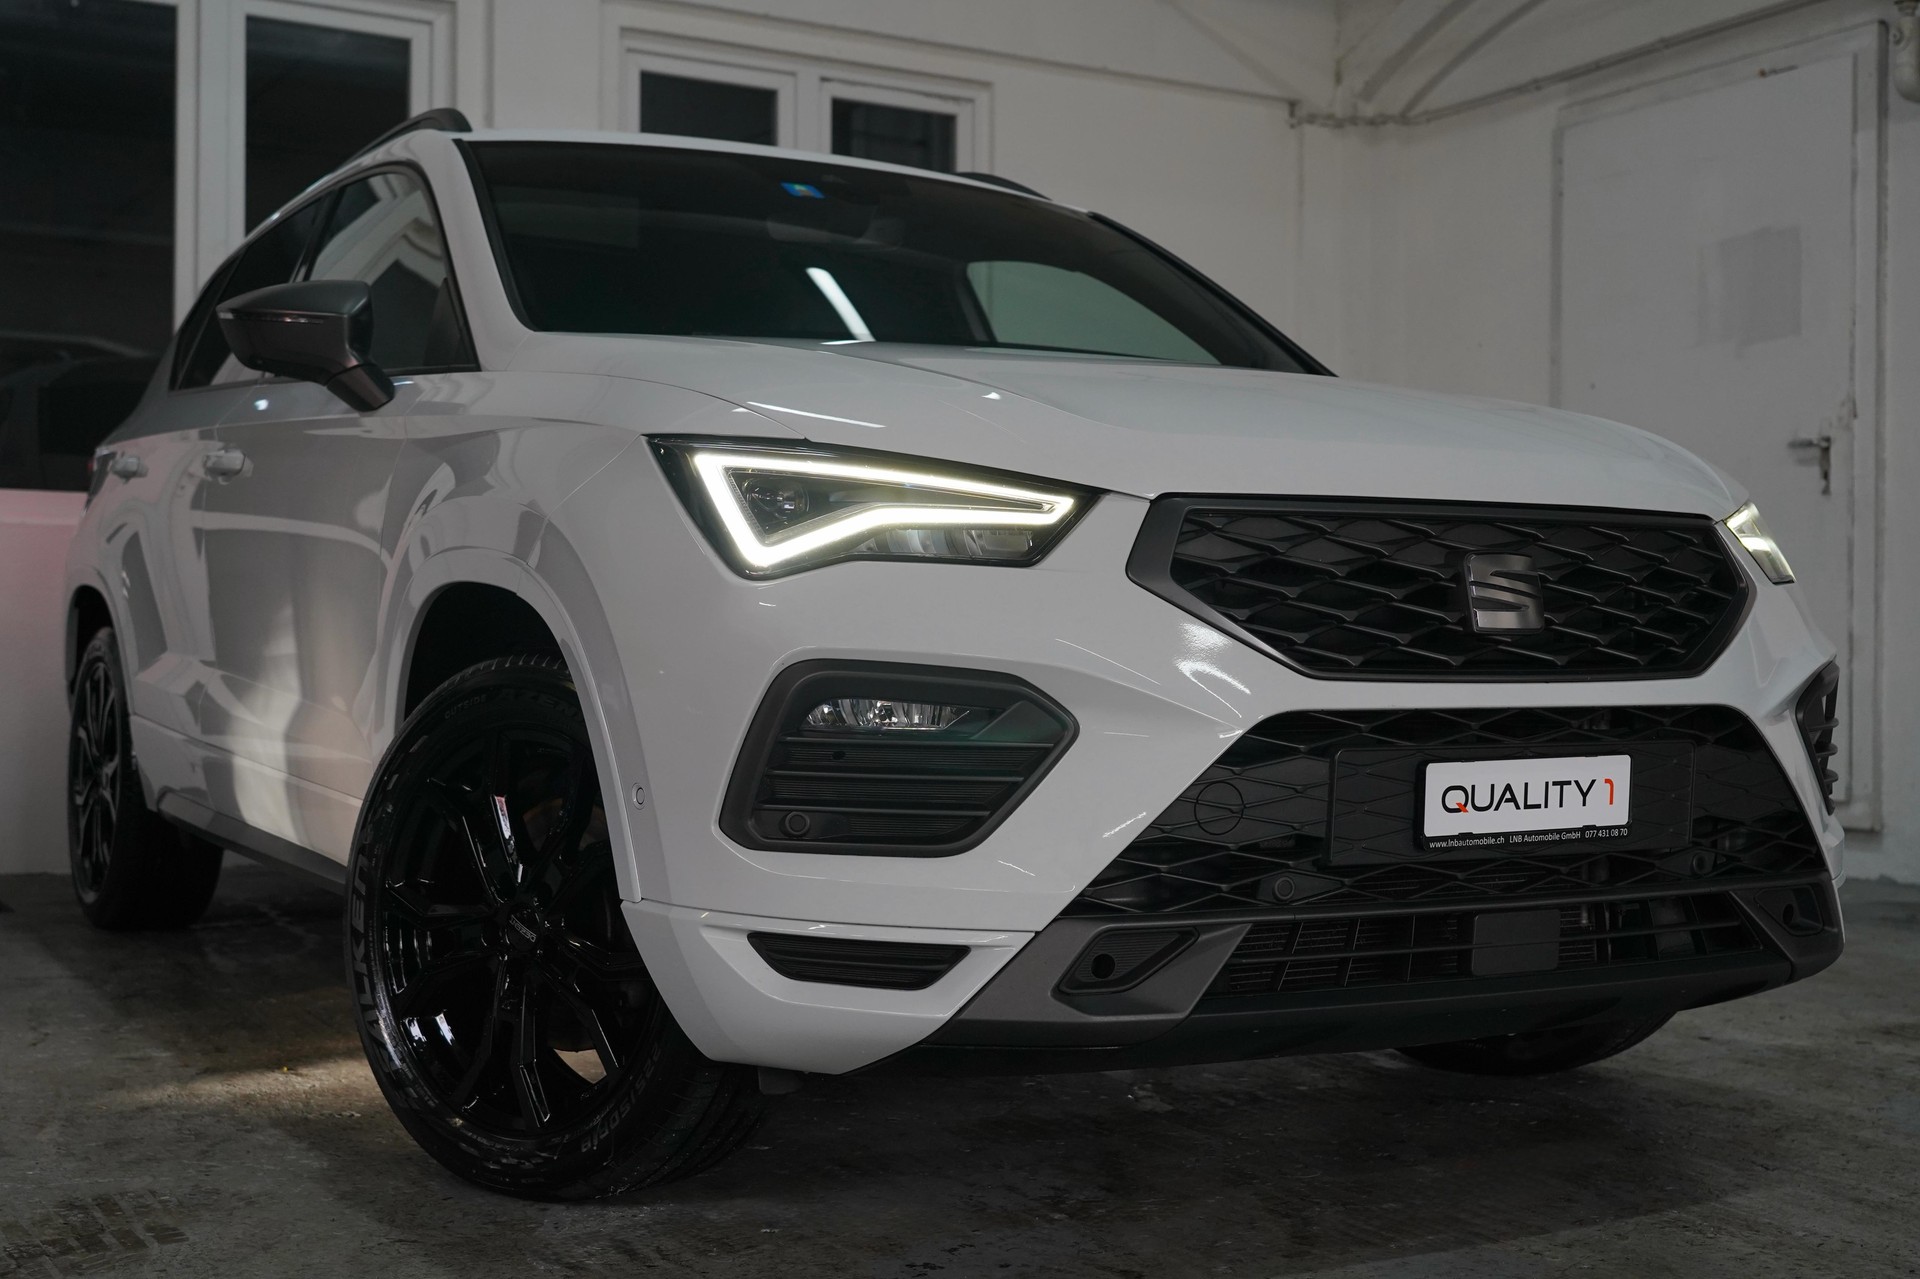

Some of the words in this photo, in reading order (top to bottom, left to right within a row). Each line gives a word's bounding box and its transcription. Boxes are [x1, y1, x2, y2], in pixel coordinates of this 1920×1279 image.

[444, 694, 487, 719] OUTSIDE
[1441, 779, 1597, 813] QUALITY
[1604, 778, 1614, 805] 1
[1429, 836, 1505, 848] www.lnbautomobile.ch
[1509, 834, 1523, 843] LNB
[1523, 832, 1560, 842] Automobile
[1561, 831, 1581, 840] GmbH
[1585, 830, 1597, 838] 077
[1598, 829, 1609, 837] 431
[1610, 828, 1619, 837] 08
[1619, 828, 1629, 836] 70
[350, 854, 401, 1074] FALKEN
